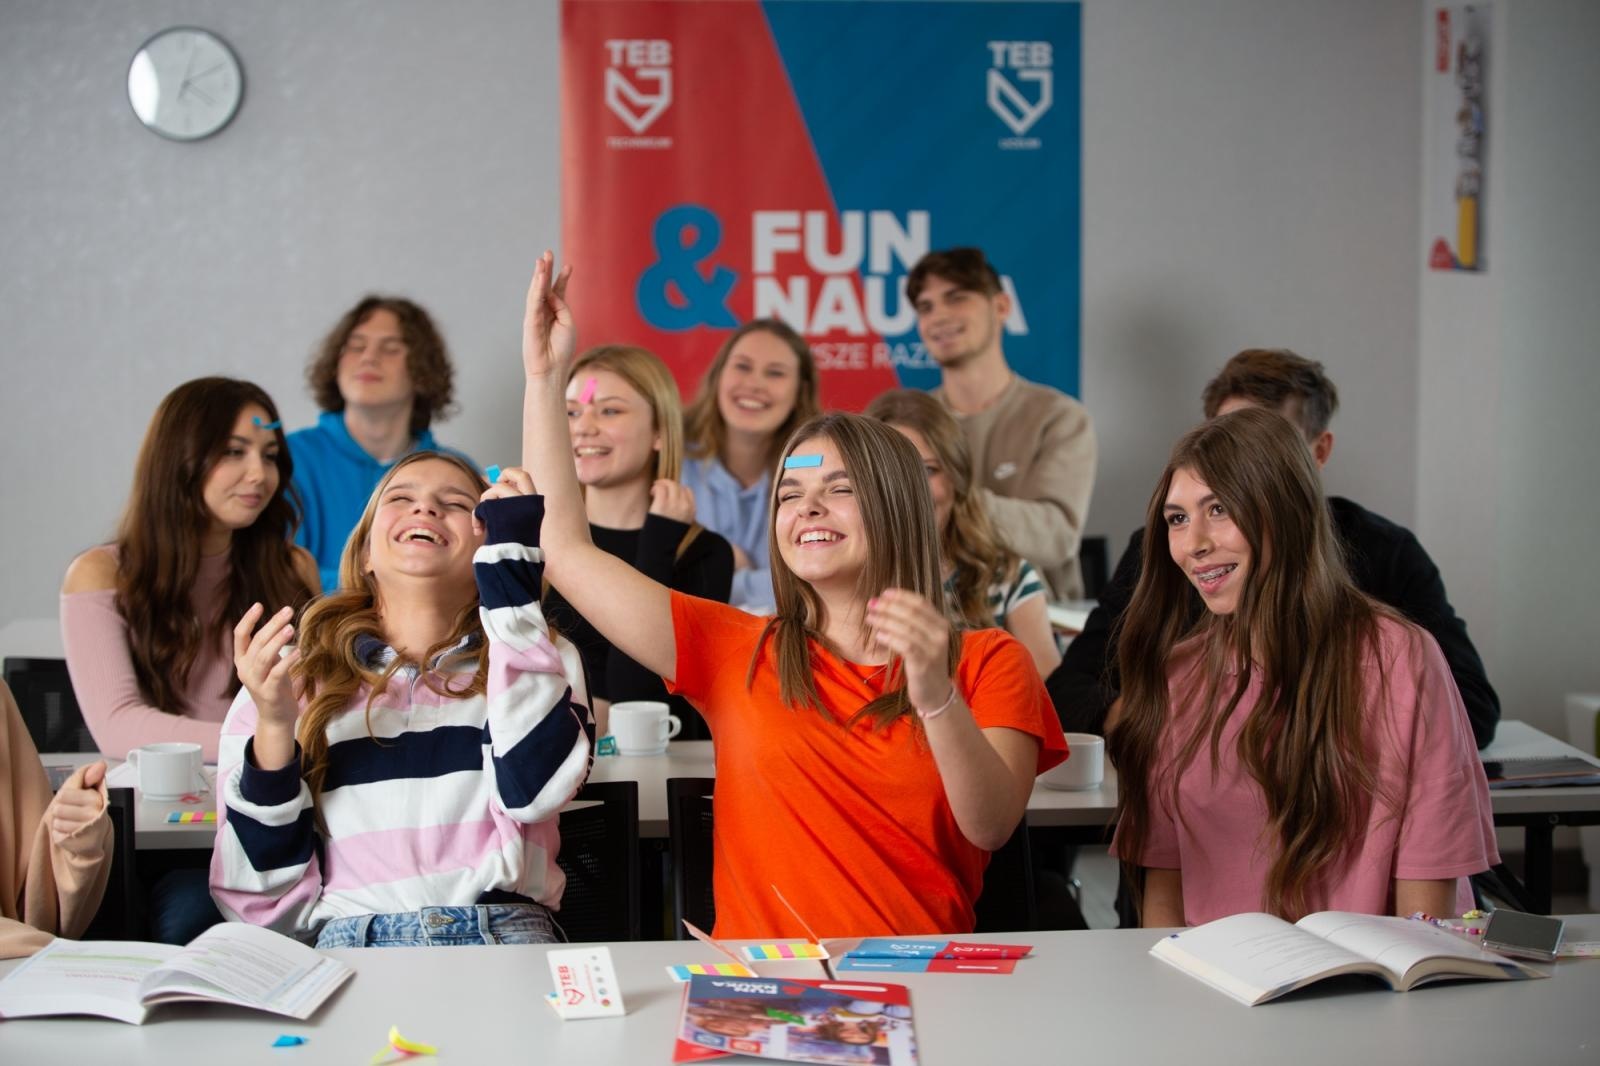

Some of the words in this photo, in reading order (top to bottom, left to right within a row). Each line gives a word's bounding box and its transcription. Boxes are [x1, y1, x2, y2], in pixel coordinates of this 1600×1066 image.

[605, 40, 671, 66] TEB
[987, 41, 1052, 67] TEB
[753, 211, 930, 273] FUN
[636, 204, 740, 331] &
[558, 965, 572, 986] TEB
